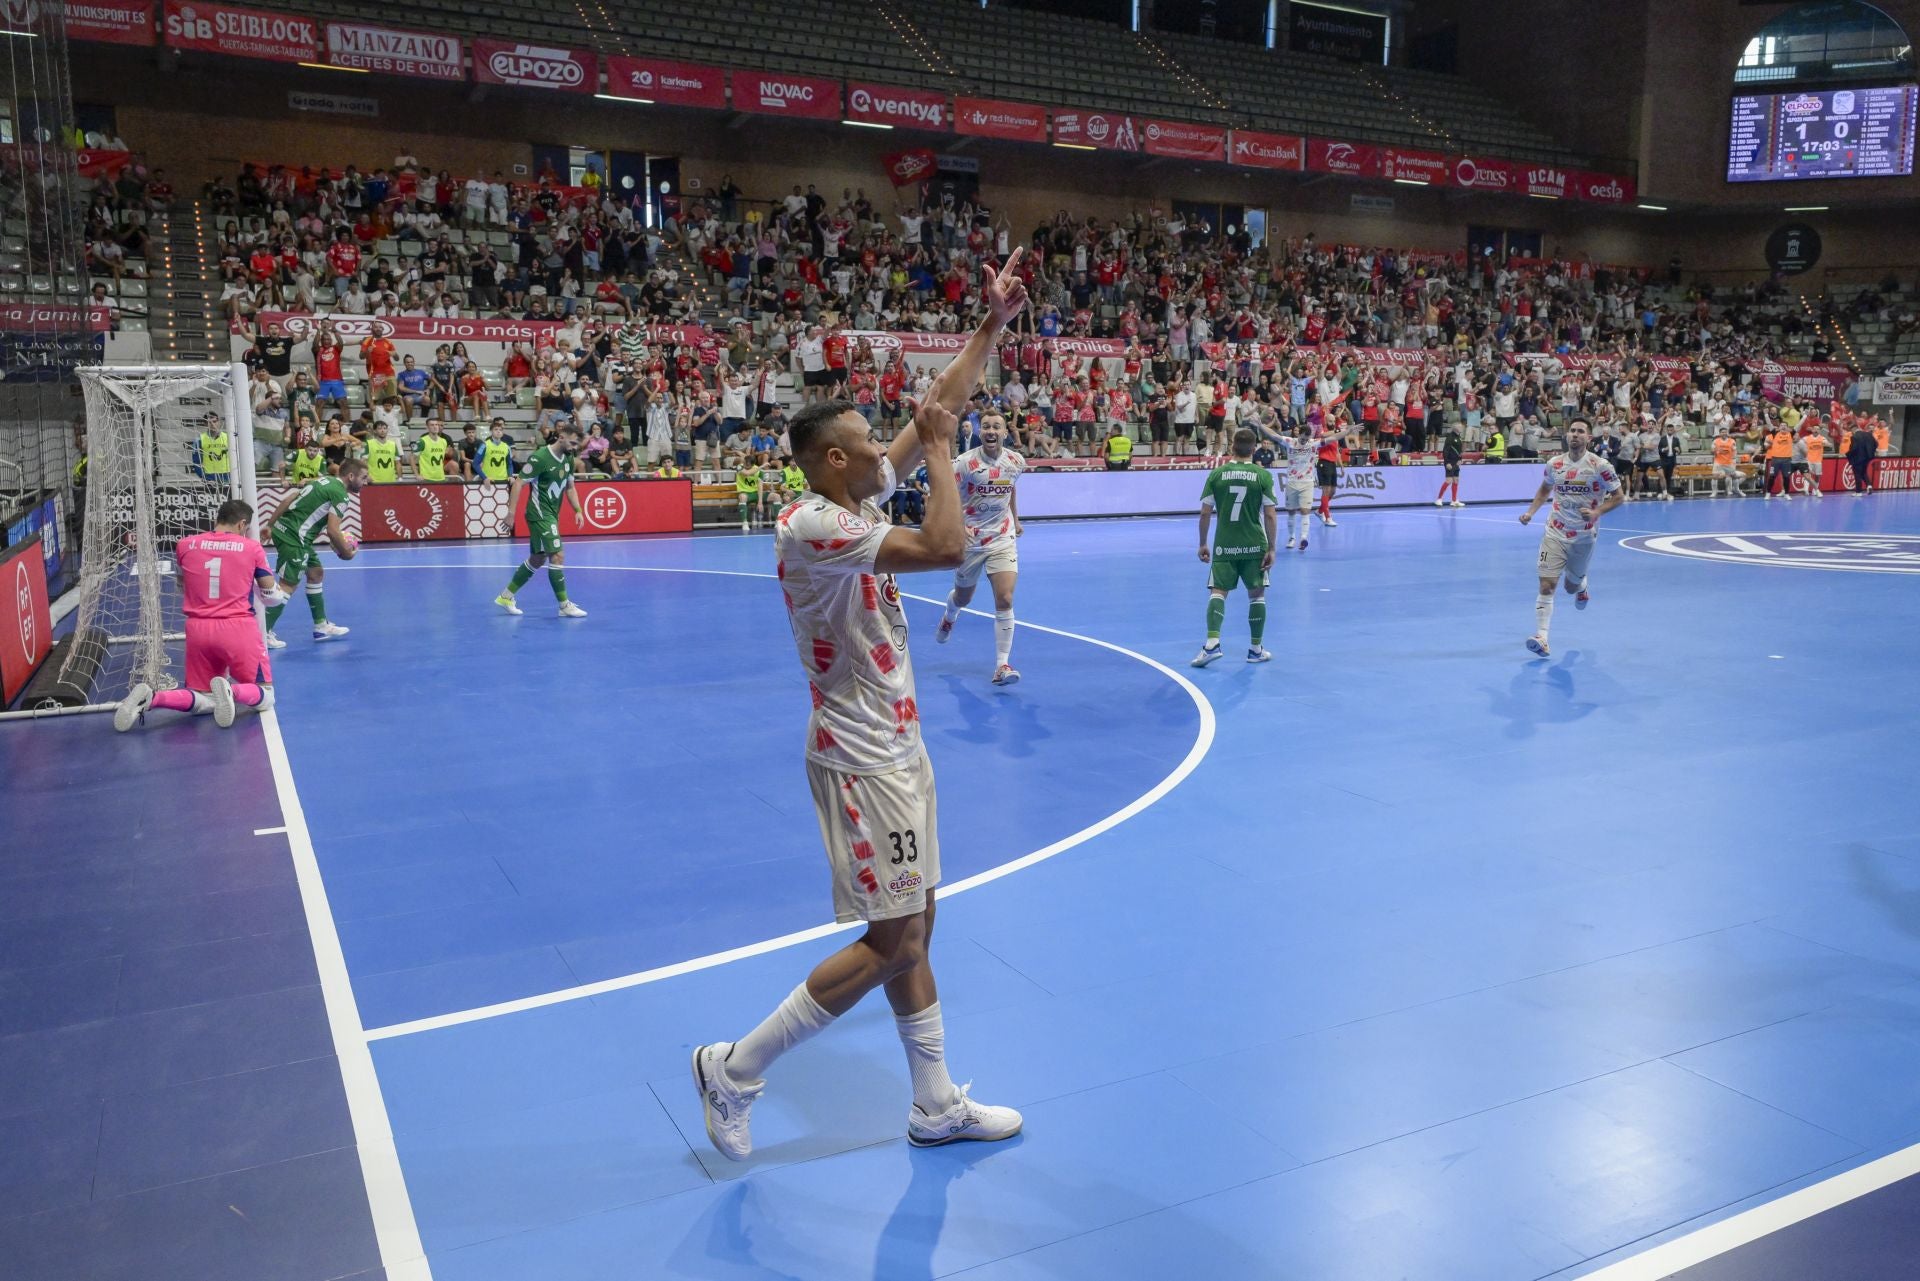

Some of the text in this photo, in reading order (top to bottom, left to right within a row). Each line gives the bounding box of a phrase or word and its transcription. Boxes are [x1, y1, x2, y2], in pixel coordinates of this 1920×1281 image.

[216, 11, 314, 45] SEIBLOCK
[340, 27, 449, 61] MANZANO
[330, 53, 460, 78] ACEITES DE OLIVA
[760, 81, 813, 101] NOVAC
[1796, 123, 1806, 139] 1
[1834, 121, 1849, 138] 0
[1250, 143, 1298, 160] CaixaBank
[1802, 141, 1840, 152] 17:03
[1397, 155, 1444, 169] Ayuntamiento
[1824, 153, 1832, 161] 2
[1397, 170, 1431, 181] de Murcia
[1528, 169, 1566, 188] UCAM
[418, 321, 473, 337] Uno
[485, 321, 532, 338] más
[917, 334, 958, 348] Uno
[1052, 337, 1113, 355] familia
[1784, 383, 1817, 399] SIEMPRE
[1221, 470, 1257, 482] HARRISON
[1229, 485, 1248, 522] 7
[384, 509, 411, 540] SUELA
[189, 540, 244, 552] J. HERRERO
[301, 553, 309, 567] 2
[204, 557, 222, 599] 1
[888, 829, 918, 865] 33
